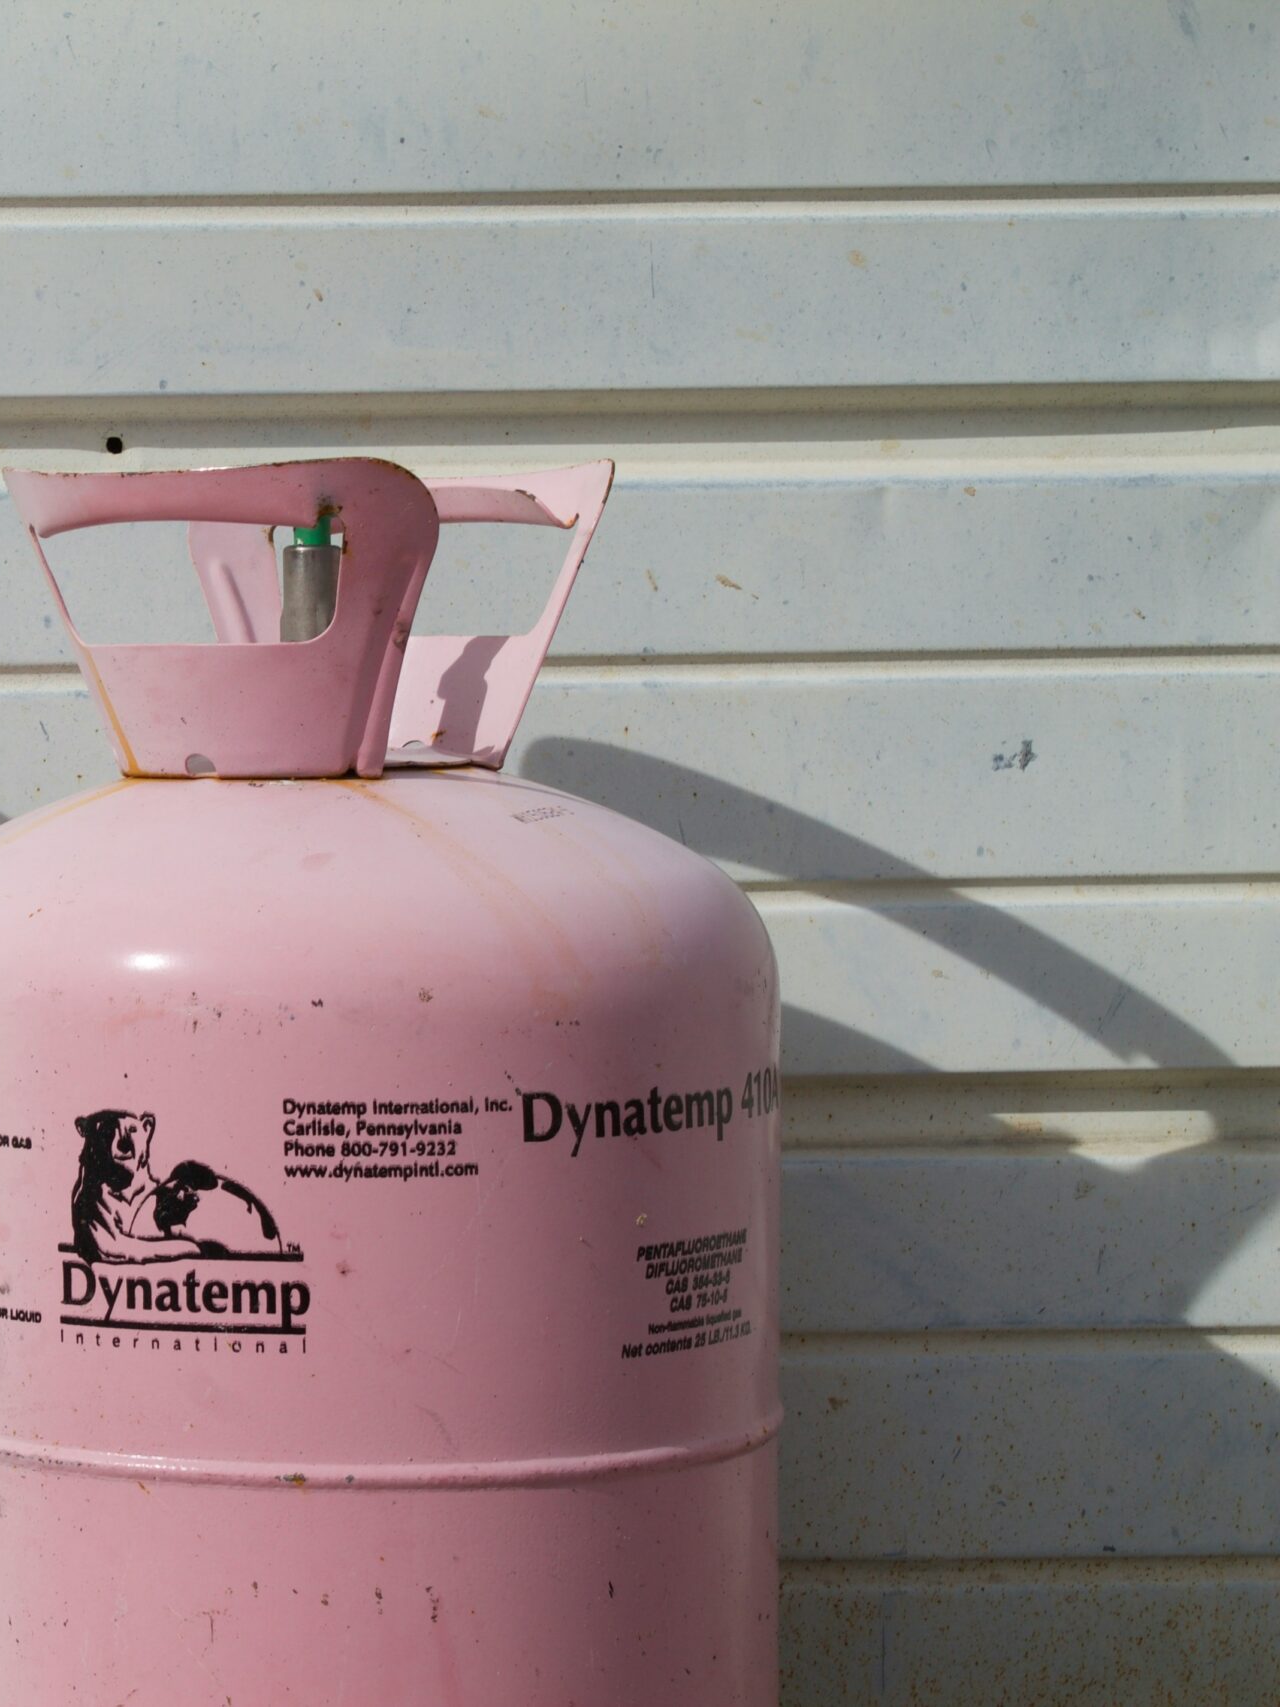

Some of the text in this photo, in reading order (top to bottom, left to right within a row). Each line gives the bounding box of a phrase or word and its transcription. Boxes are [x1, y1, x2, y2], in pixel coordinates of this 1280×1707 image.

[282, 1096, 513, 1118] Dynatemp International, Inc.
[522, 1063, 779, 1158] Dynatemp 410A
[282, 1119, 462, 1140] Carlisle, Pennsylvania
[283, 1139, 456, 1157] Phone 800-791-9232
[284, 1162, 479, 1182] www.dynatempintl.com
[636, 1228, 747, 1262] PENTAFLUOROETHANE
[645, 1247, 742, 1280] DIFLUOROMETHANE
[61, 1260, 311, 1328] Dynatemp
[665, 1277, 689, 1295] CAS
[670, 1295, 692, 1312] CAS
[10, 1309, 42, 1323] LIQUID
[60, 1329, 307, 1354] International
[621, 1343, 642, 1358] Net
[645, 1336, 692, 1356] contents
